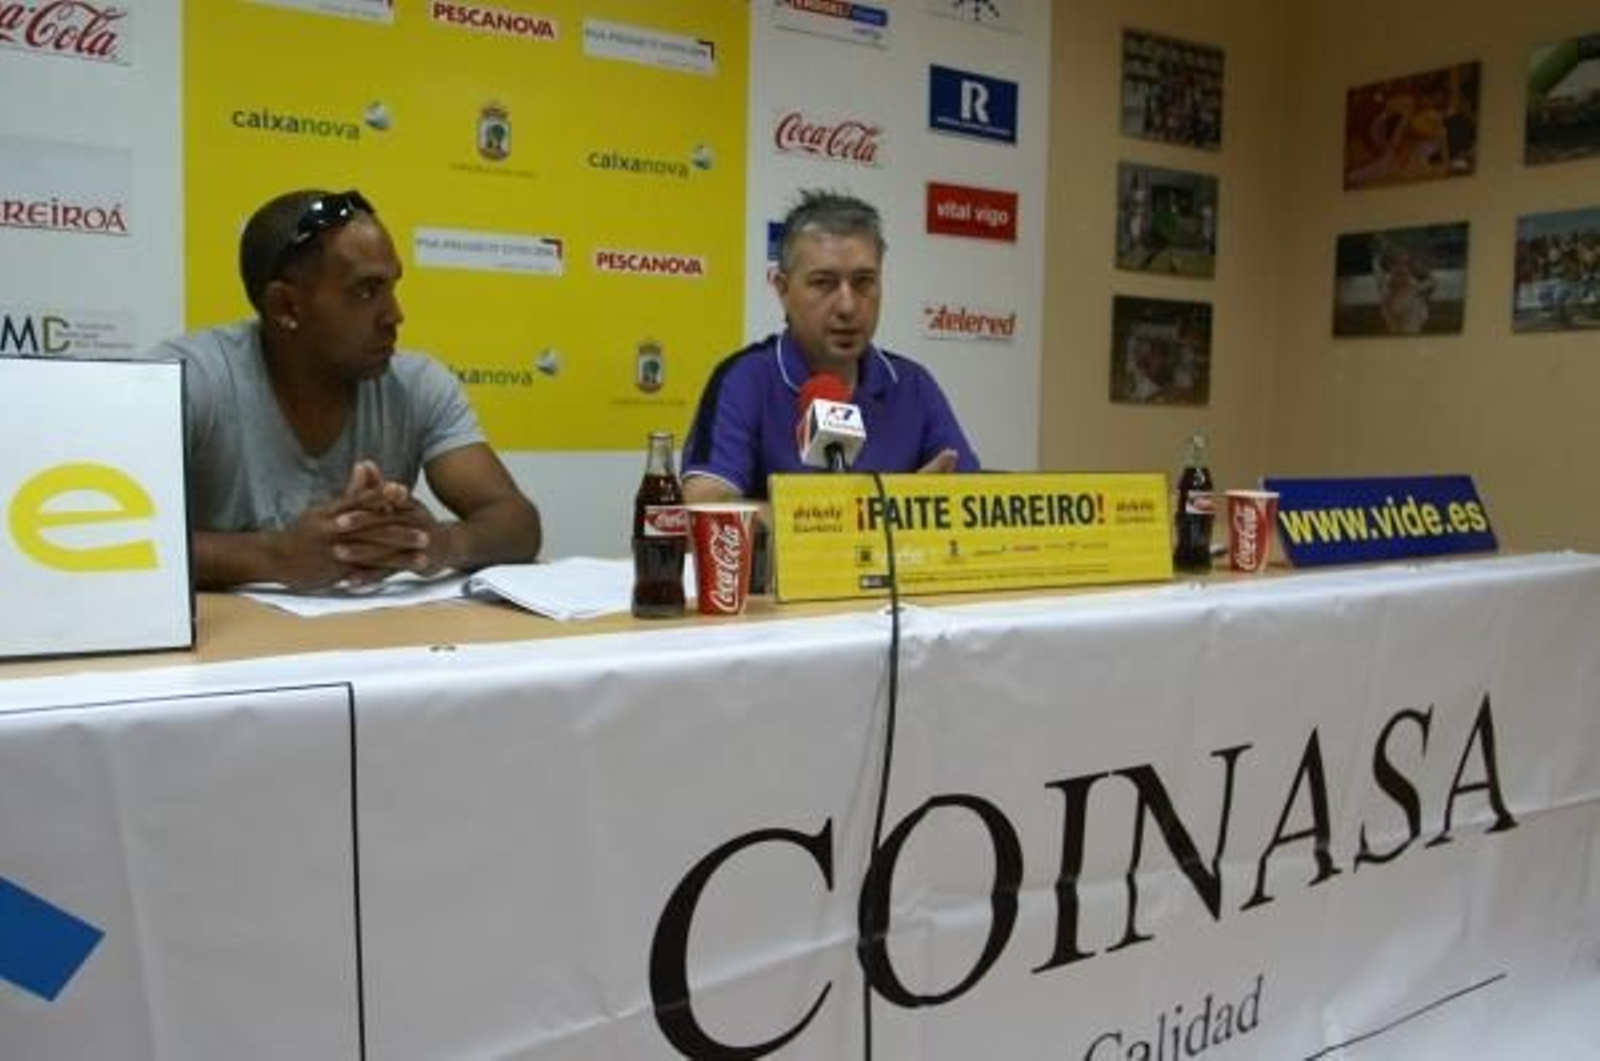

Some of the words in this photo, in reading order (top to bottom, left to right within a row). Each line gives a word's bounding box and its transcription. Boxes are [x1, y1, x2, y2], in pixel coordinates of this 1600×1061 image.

[432, 2, 555, 39] PESCANOVA
[962, 80, 990, 123] R
[231, 107, 361, 140] caixanova
[588, 150, 690, 178] caixanova
[938, 202, 971, 220] vital
[975, 206, 1009, 227] vigo
[597, 251, 703, 275] PESCANOVA
[961, 493, 1105, 528] SIAREIRO!
[1278, 497, 1488, 544] www.vide.es
[648, 692, 1519, 1061] COINASA
